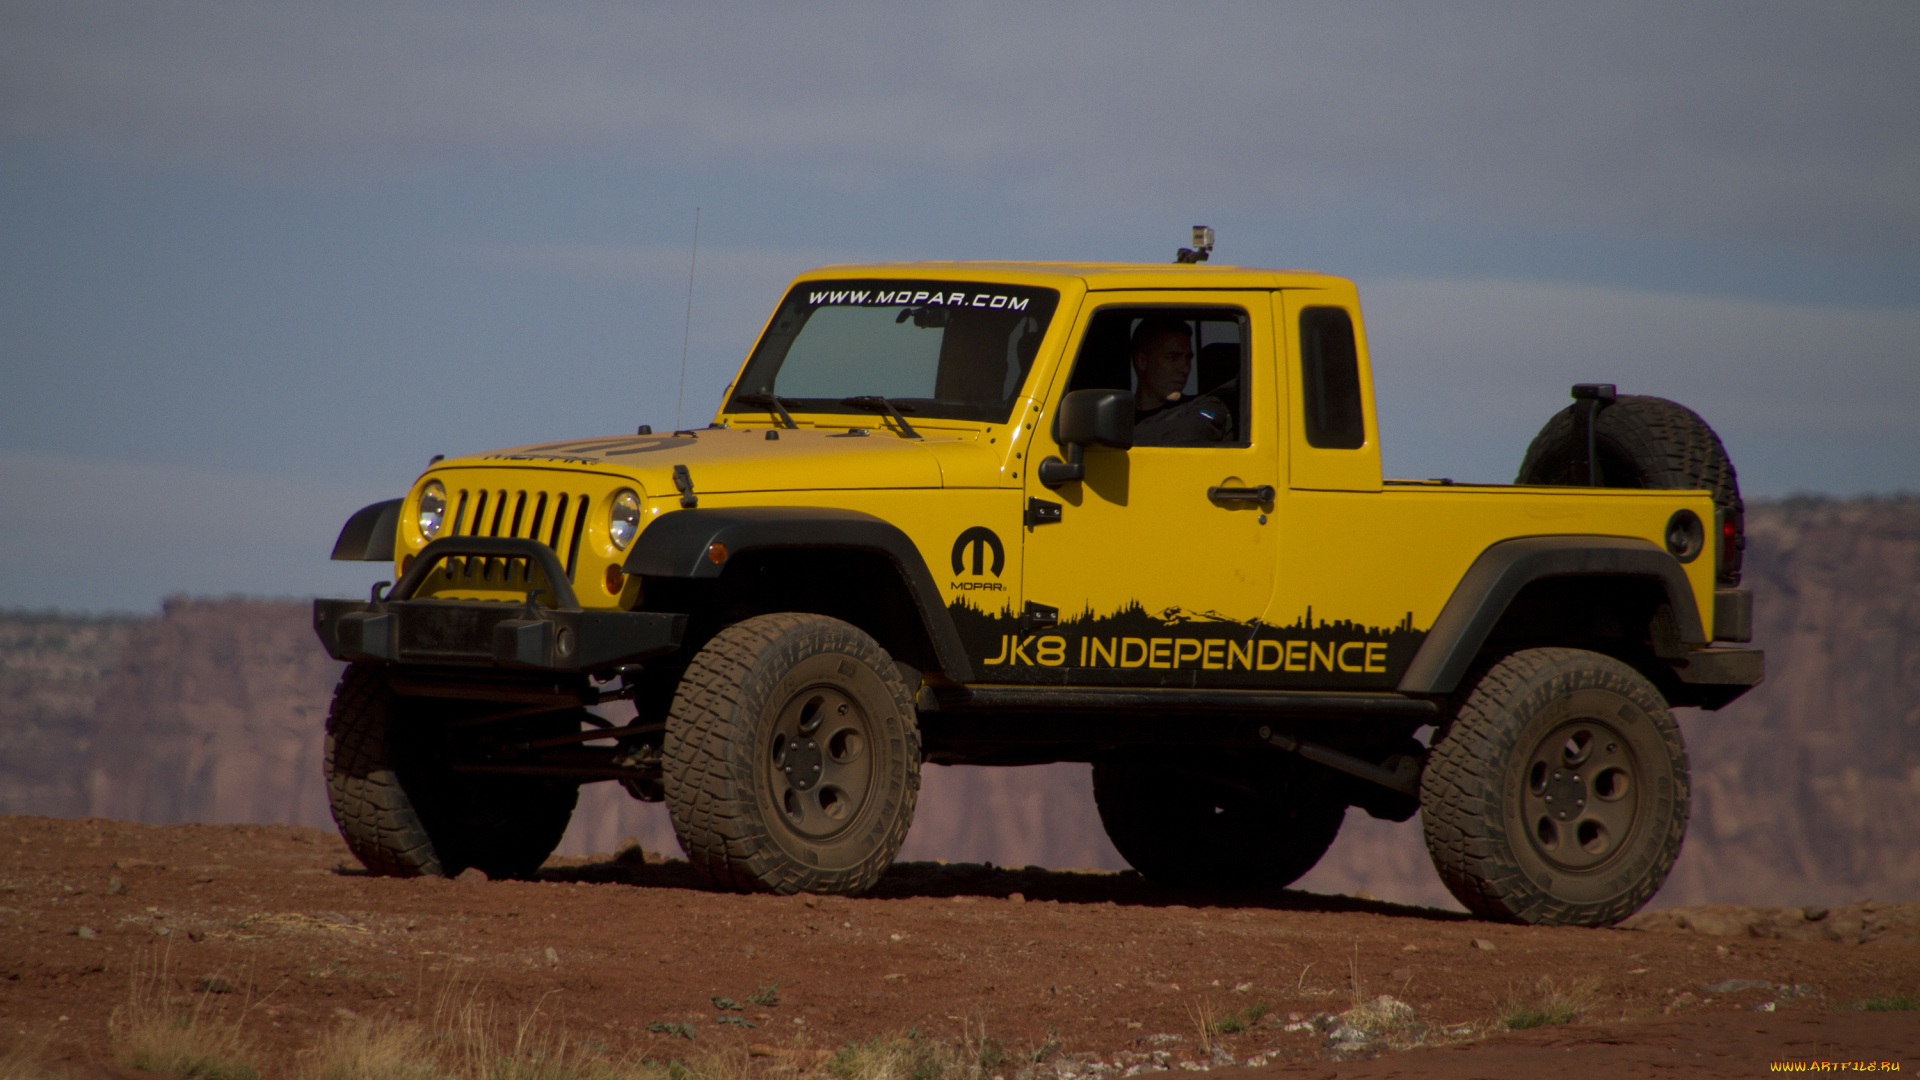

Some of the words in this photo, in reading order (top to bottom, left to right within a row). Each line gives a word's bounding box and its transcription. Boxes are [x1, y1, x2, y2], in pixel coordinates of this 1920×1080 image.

[808, 290, 1030, 312] WWW.MOPAR.COM
[984, 634, 1067, 667] JK8
[1080, 636, 1388, 674] INDEPENDENCE
